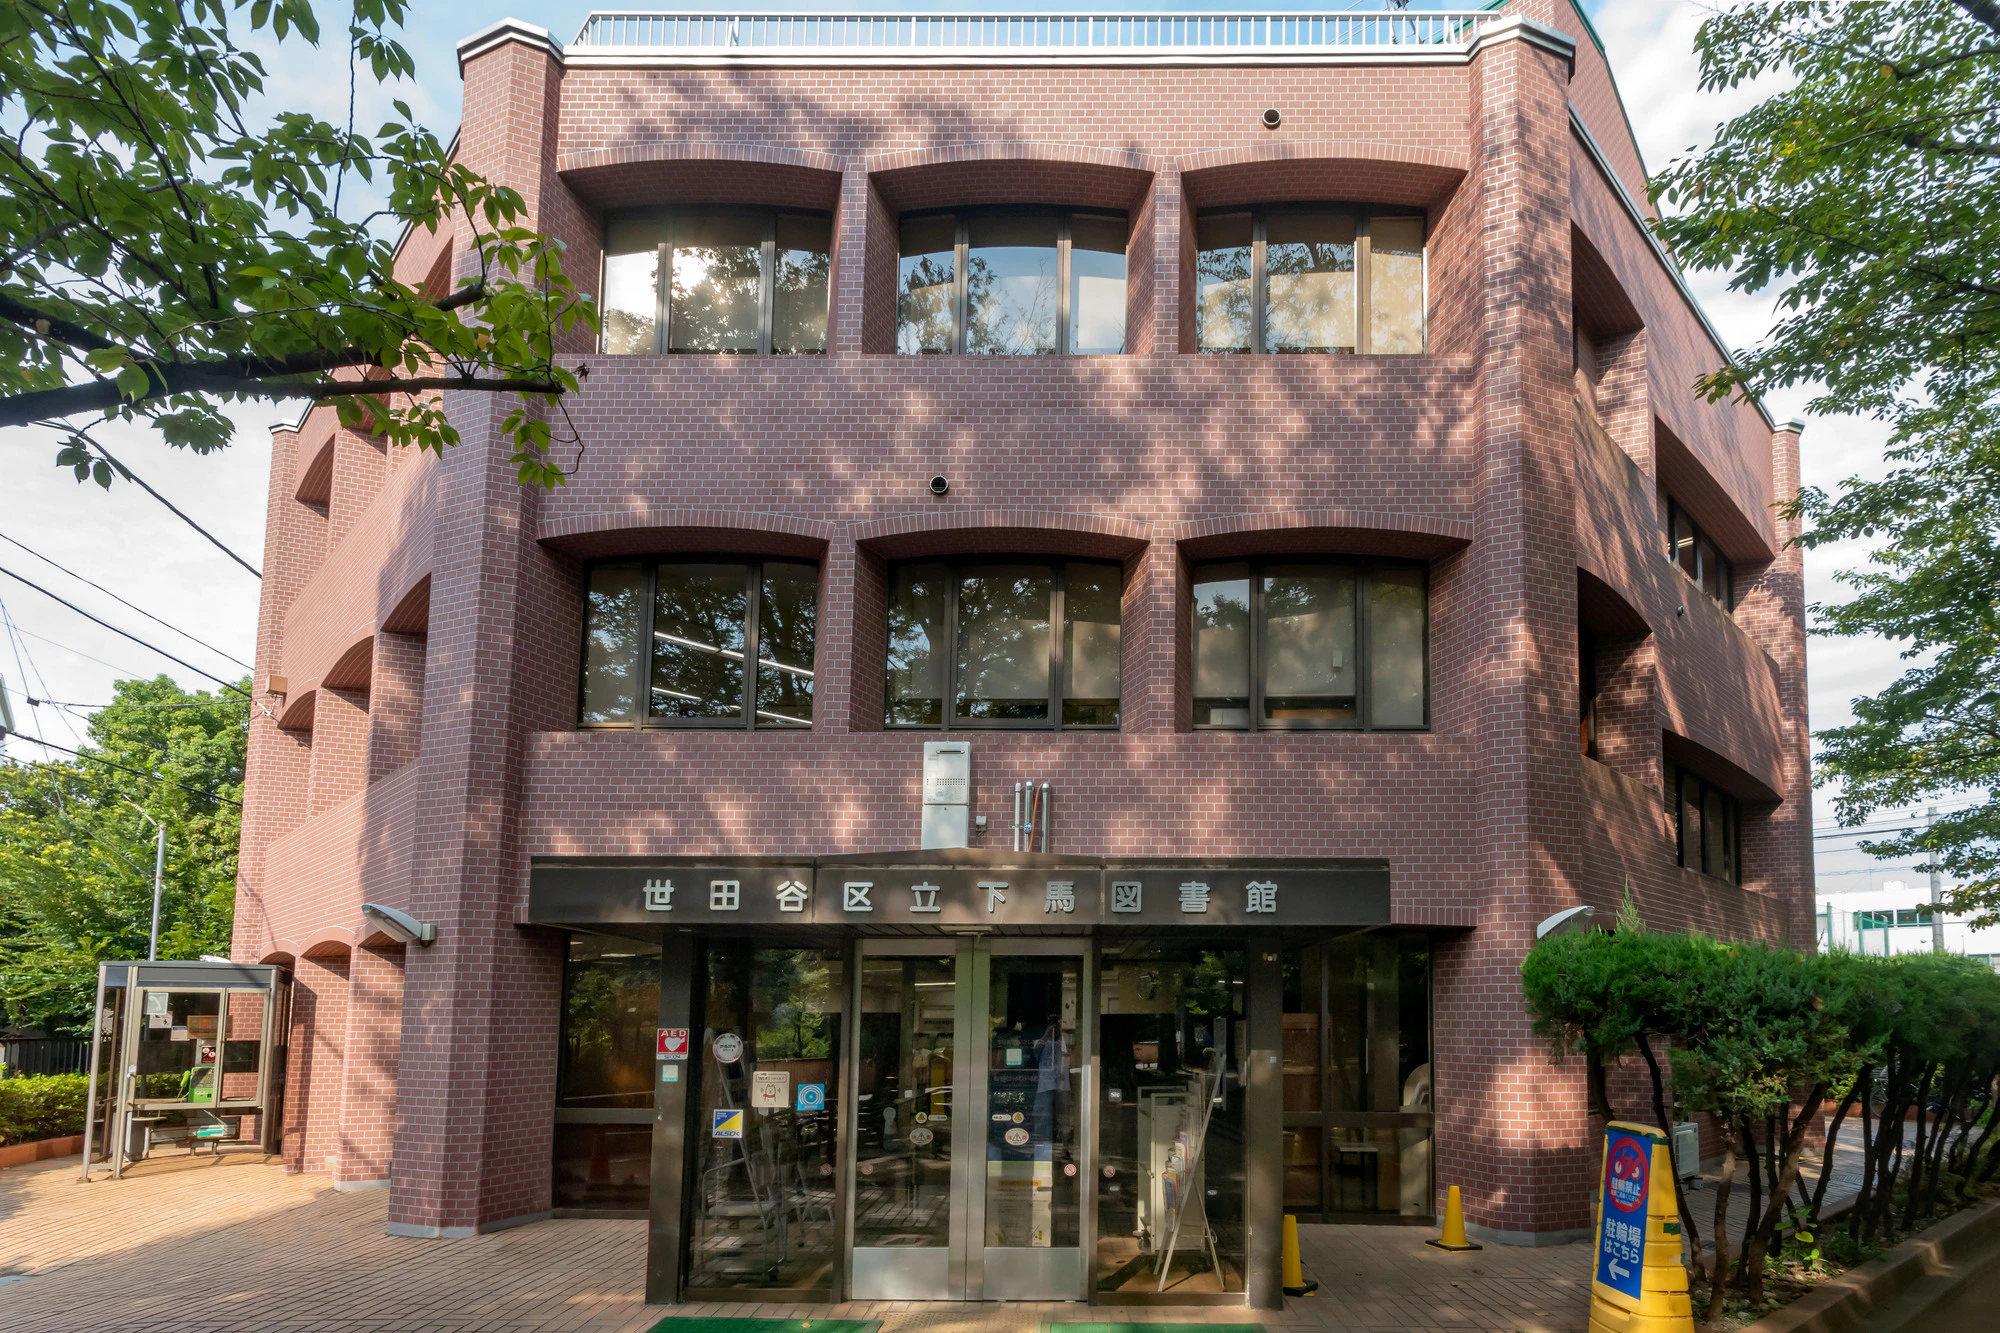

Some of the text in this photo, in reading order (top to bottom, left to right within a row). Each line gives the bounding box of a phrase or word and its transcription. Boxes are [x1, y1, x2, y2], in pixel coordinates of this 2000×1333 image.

[642, 879, 1278, 913] 世田谷区立下馬図書館
[661, 1029, 687, 1037] AED
[1605, 1217, 1641, 1248] 駐輪場
[1604, 1237, 1640, 1264] はこちら
